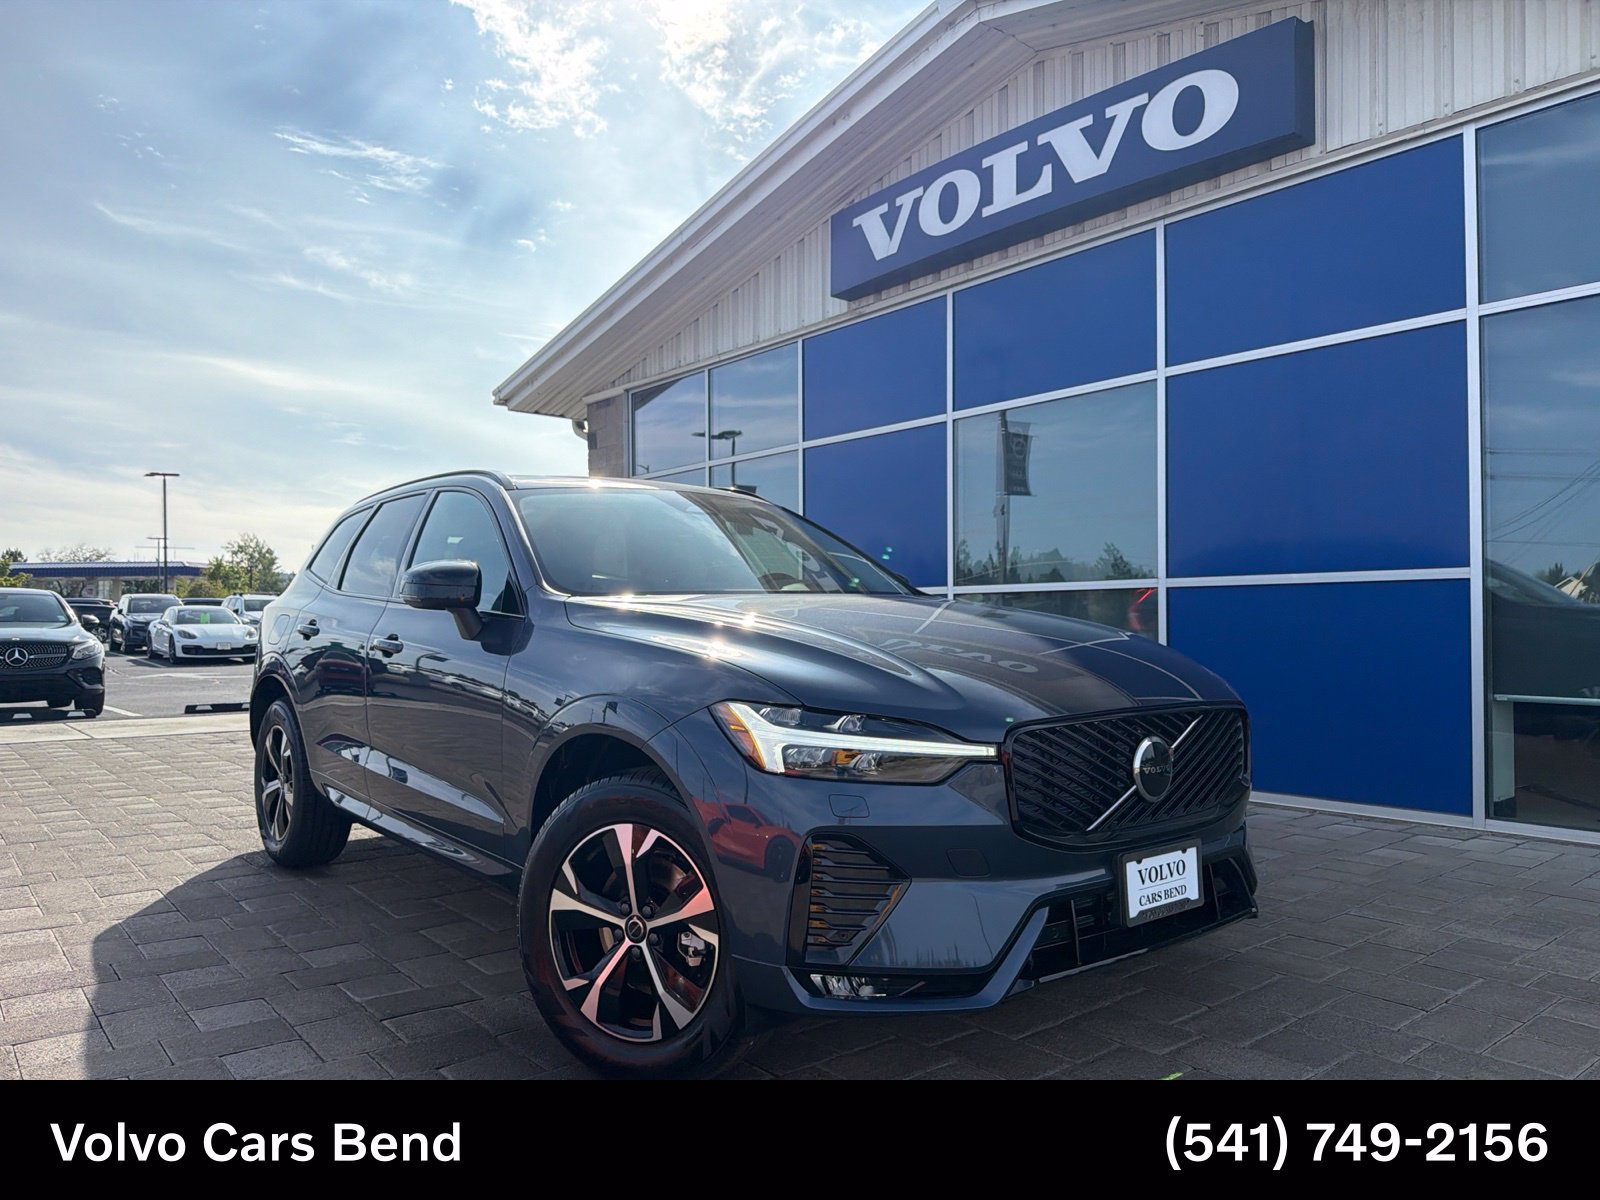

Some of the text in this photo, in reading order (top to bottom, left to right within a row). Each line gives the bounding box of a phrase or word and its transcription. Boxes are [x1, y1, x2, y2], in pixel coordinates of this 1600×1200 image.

[853, 69, 1239, 261] VOLVO
[1138, 859, 1186, 885] VOLVO
[1139, 885, 1187, 907] CARS BEND
